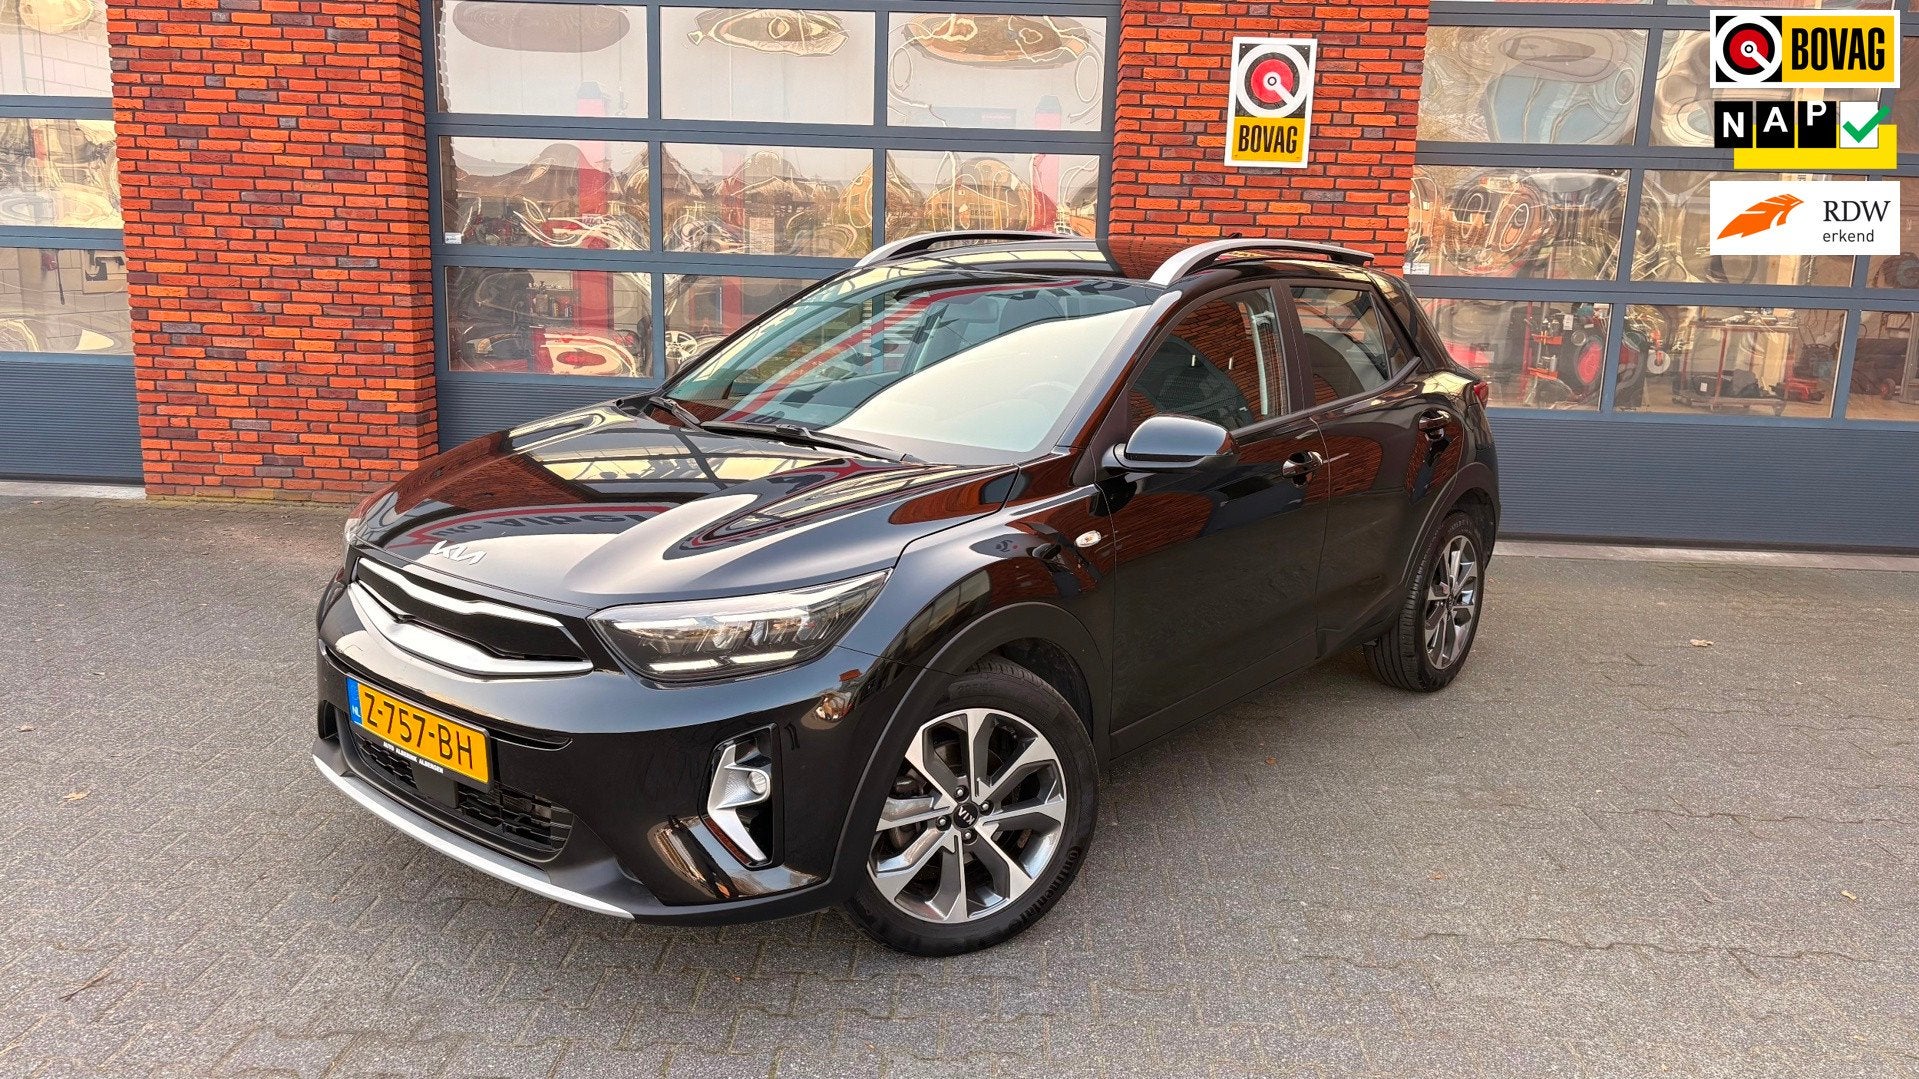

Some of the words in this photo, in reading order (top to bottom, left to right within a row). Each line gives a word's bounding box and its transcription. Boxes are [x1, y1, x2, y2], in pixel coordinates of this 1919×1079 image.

[1238, 124, 1298, 154] BOVAG
[352, 704, 361, 718] NL
[364, 691, 474, 770] Z-757-BH
[958, 805, 976, 826] KIA
